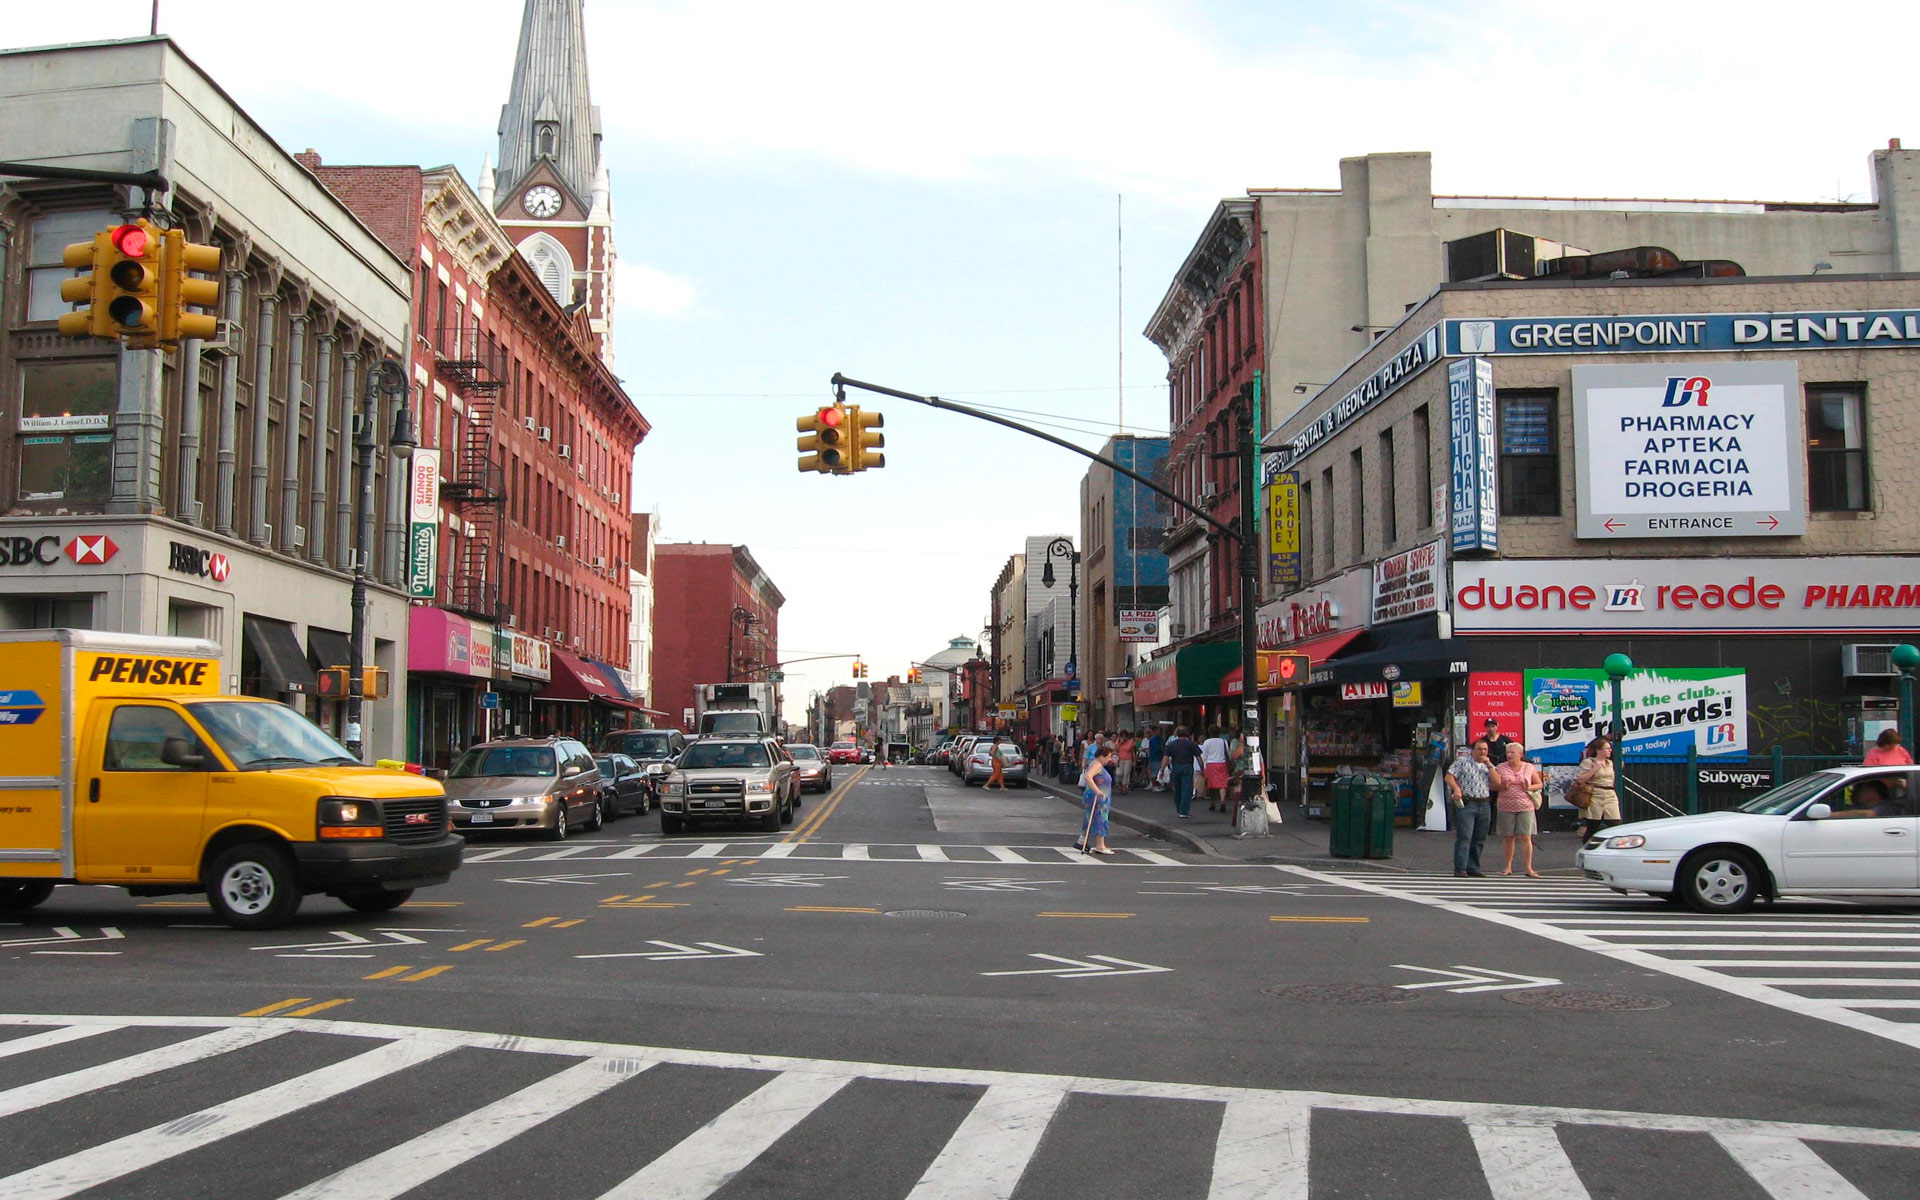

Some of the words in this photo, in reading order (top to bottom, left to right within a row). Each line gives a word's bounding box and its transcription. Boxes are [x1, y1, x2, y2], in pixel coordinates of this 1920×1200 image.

[1510, 321, 1706, 348] GREENPOINT
[1733, 316, 1920, 343] DENTAL
[1293, 419, 1324, 457] DENTAL
[1327, 411, 1334, 432] &
[1337, 376, 1380, 425] MEDICAL
[1383, 343, 1423, 389] PLAZA
[1451, 382, 1462, 492] DENTAL
[1477, 378, 1487, 490] DENTAL
[1620, 414, 1755, 432] PHARMACY
[1461, 379, 1474, 510] MEDICAL
[1485, 380, 1495, 511] MEDICAL
[1643, 436, 1742, 453] APTEKA
[1274, 474, 1294, 484] SPA
[1624, 458, 1750, 475] FARMACIA
[417, 465, 425, 505] DONUTS
[425, 466, 434, 507] DUNKIN'
[1625, 480, 1753, 497] DROGERIA
[1287, 488, 1295, 549] BEAUTY
[1453, 514, 1475, 529] PLAZA
[1648, 517, 1733, 529] ENTRANCE
[169, 541, 210, 577] HSBC
[412, 527, 433, 593] Nathan's
[1458, 577, 1596, 610] duane
[1657, 576, 1785, 610] reade
[88, 656, 208, 686] PENSKE
[1450, 661, 1468, 673] ATM
[1344, 682, 1386, 697] ATM
[1641, 693, 1671, 707] the
[1677, 685, 1731, 700] club...
[1542, 708, 1593, 740] get
[1633, 744, 1643, 752] up
[1646, 739, 1671, 749] today!
[1698, 770, 1761, 786] Subway
